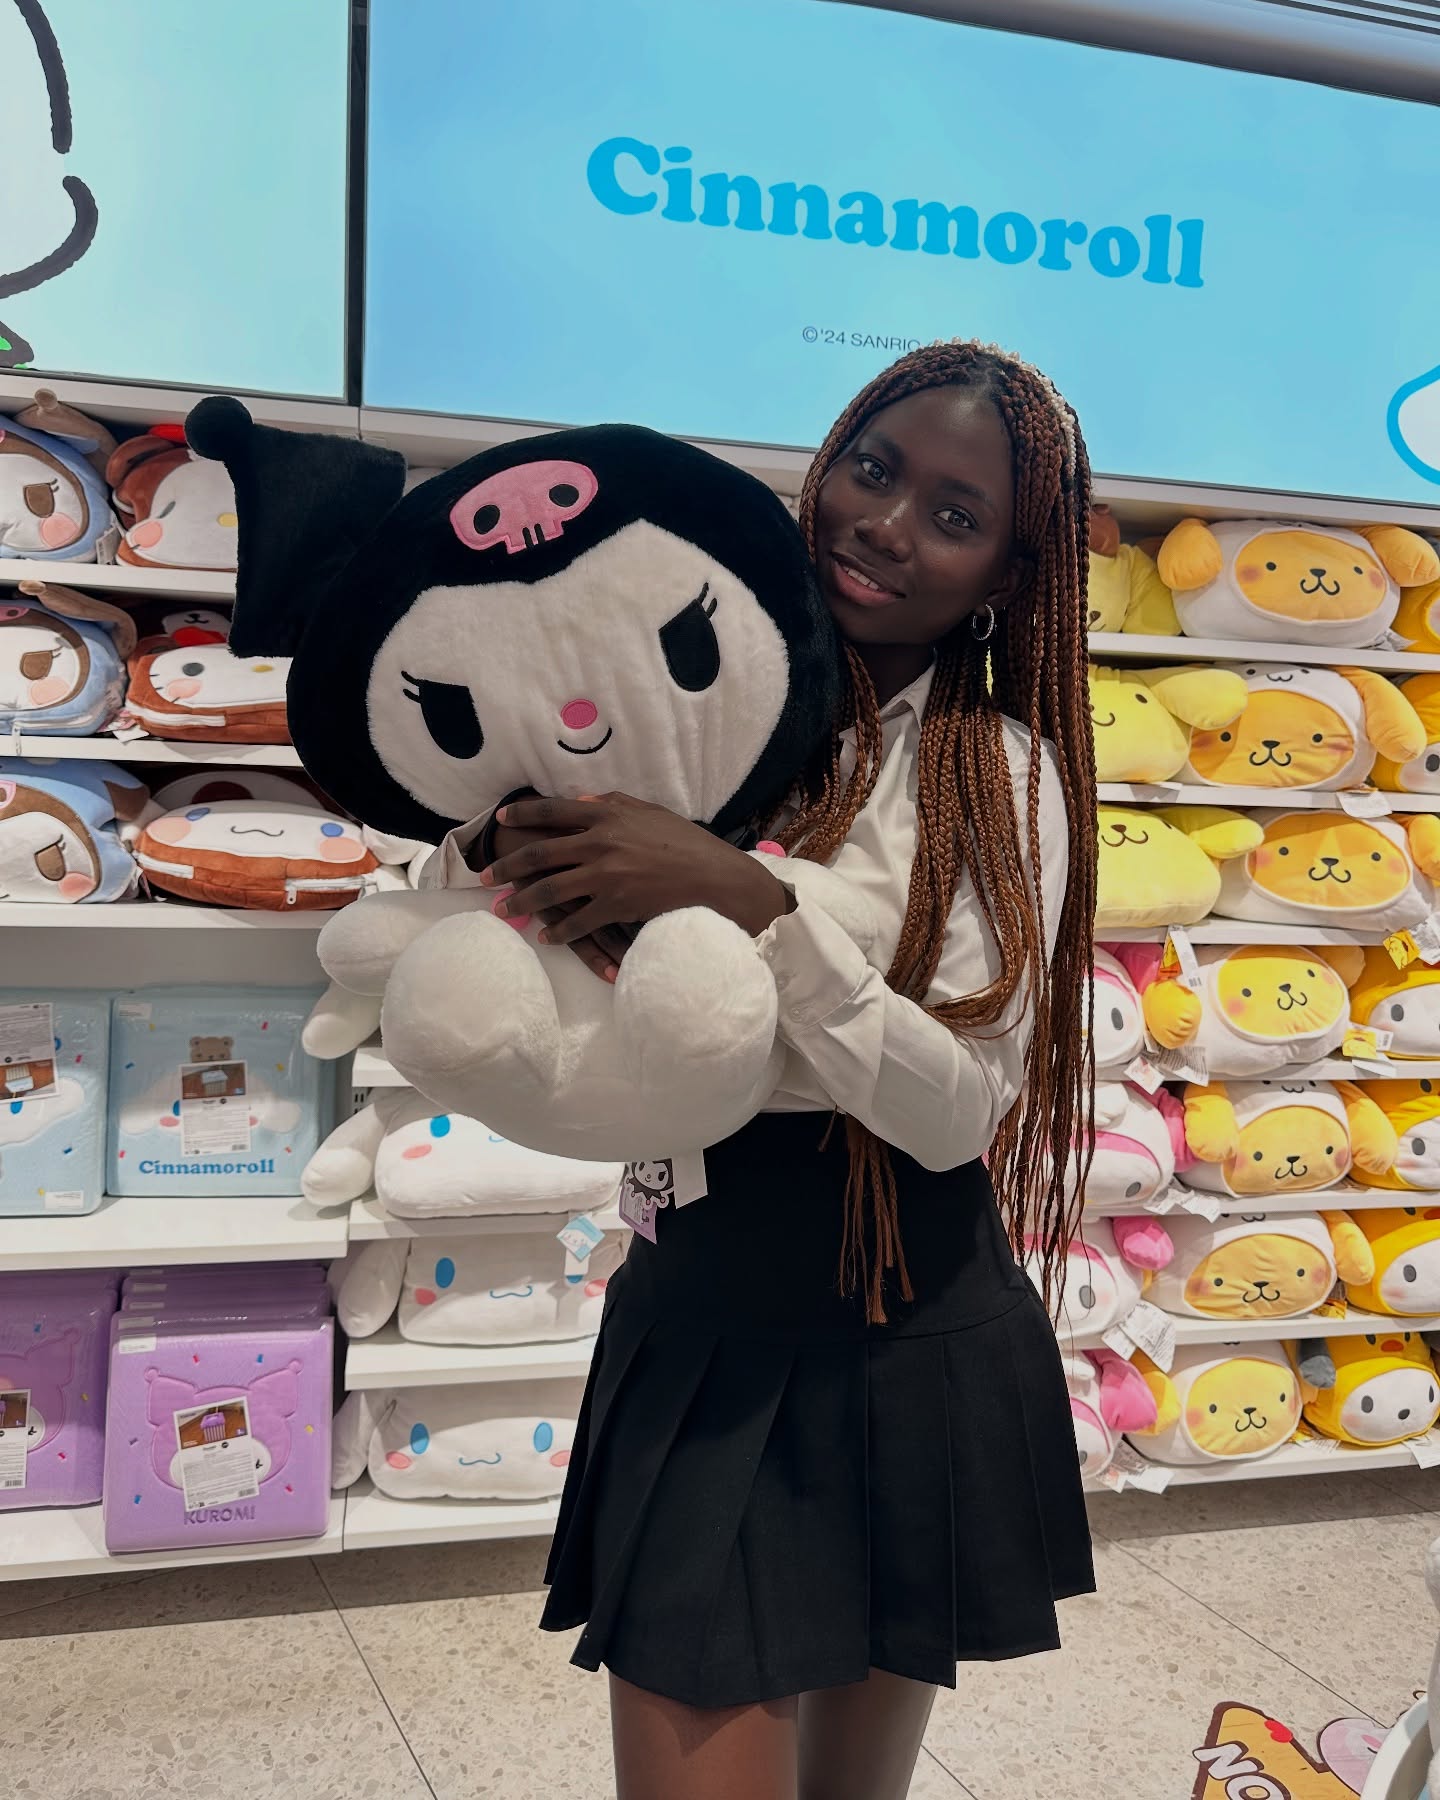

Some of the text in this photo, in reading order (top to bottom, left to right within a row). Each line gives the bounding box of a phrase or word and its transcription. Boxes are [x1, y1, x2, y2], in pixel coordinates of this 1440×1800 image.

[587, 136, 1205, 288] Cinnamoroll
[851, 333, 921, 351] SANRIO
[139, 1158, 275, 1174] Cinnamoroll
[184, 1505, 256, 1525] KUROMI
